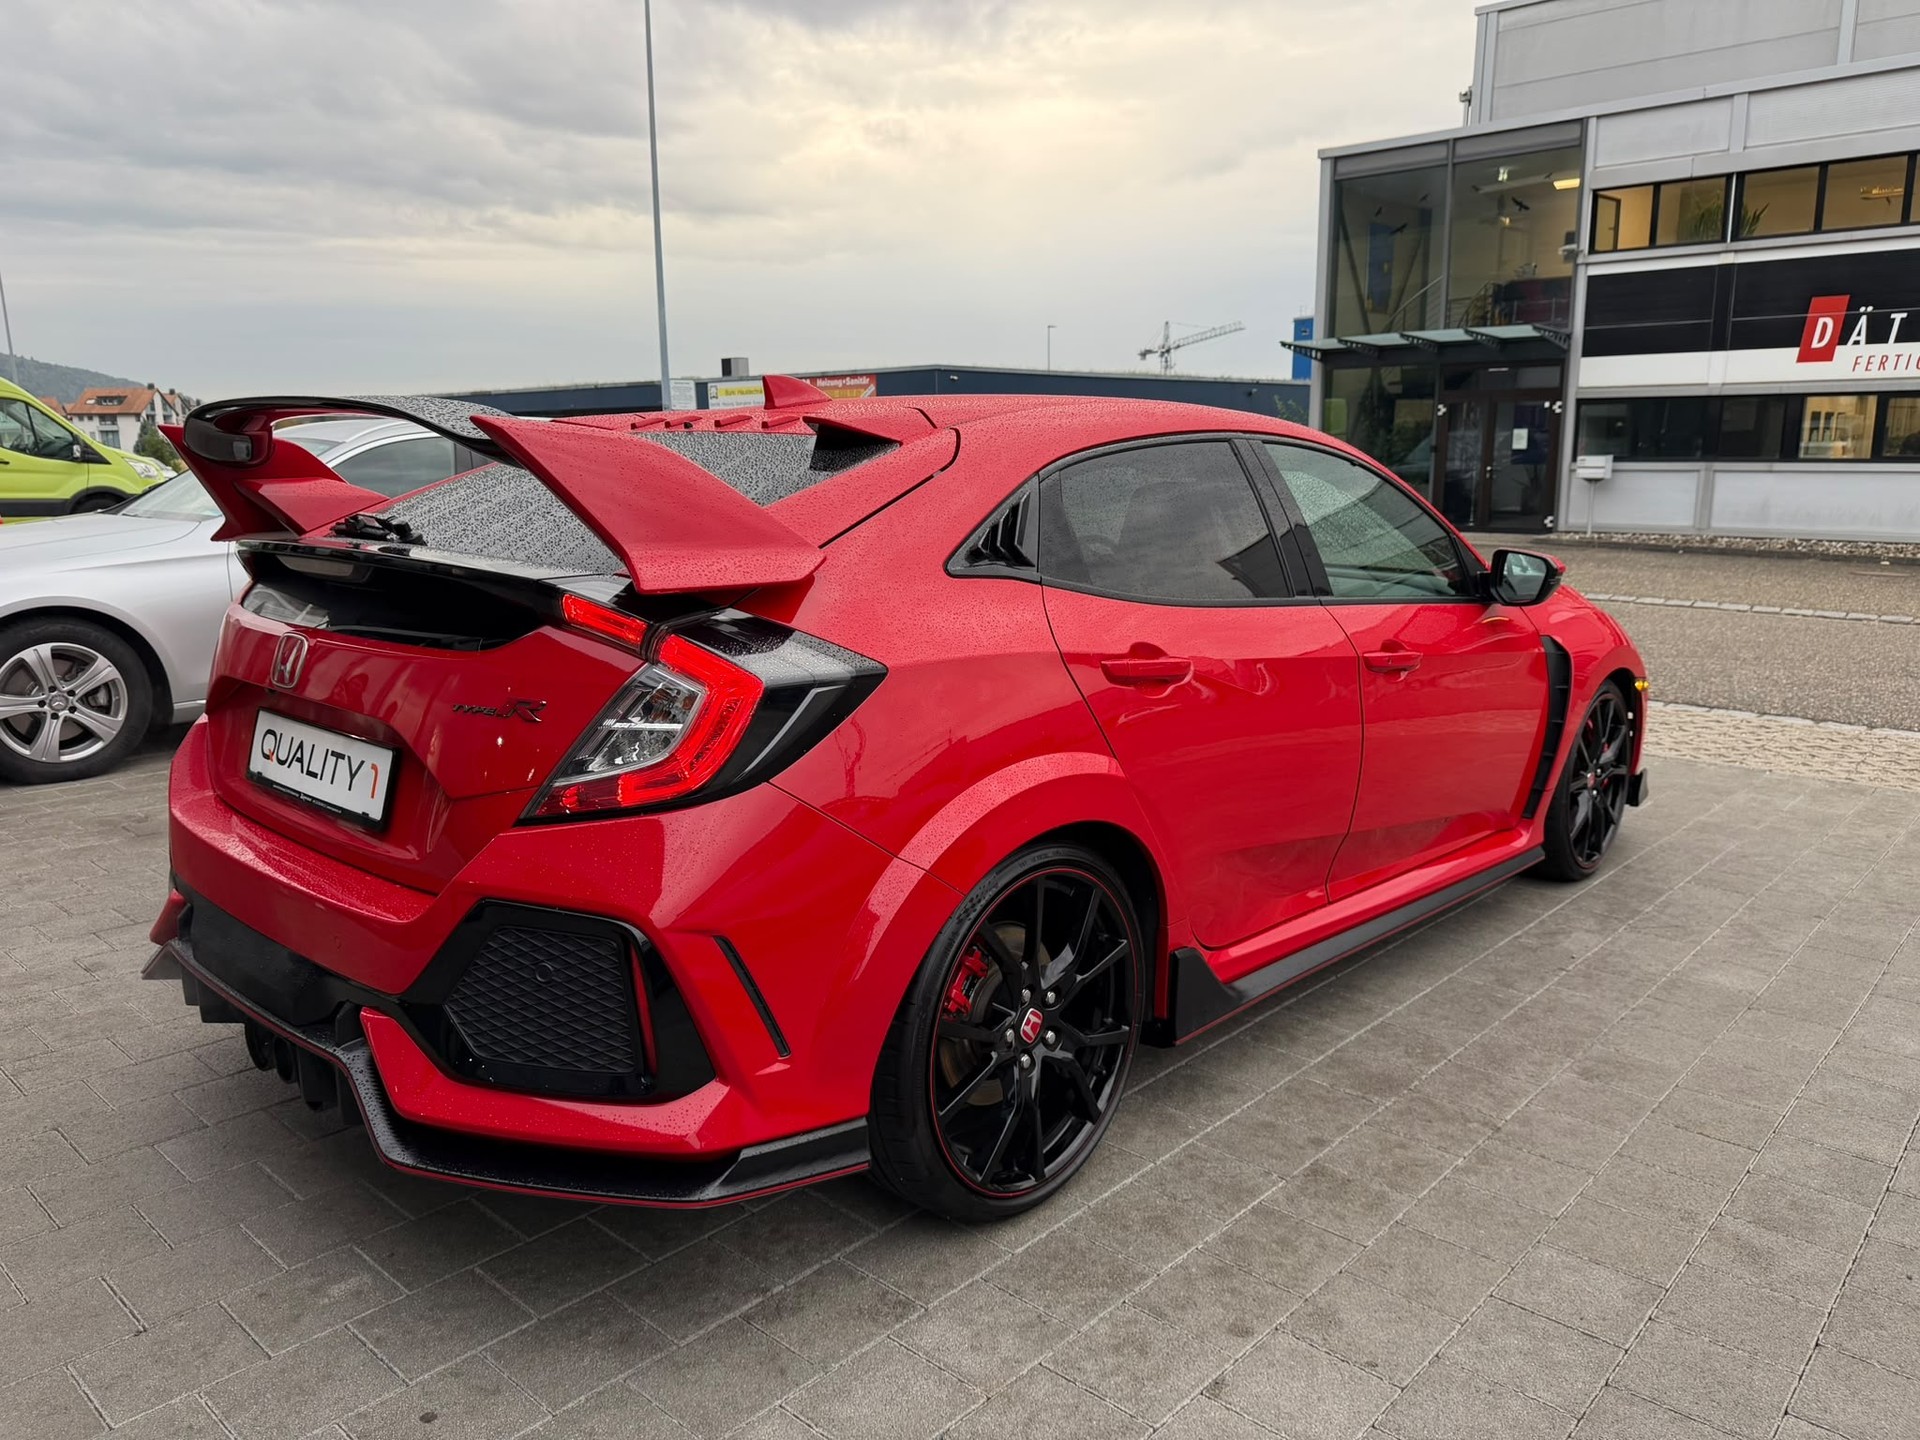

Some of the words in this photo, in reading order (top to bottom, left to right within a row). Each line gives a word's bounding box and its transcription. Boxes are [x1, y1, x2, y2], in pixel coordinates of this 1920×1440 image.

[816, 378, 842, 387] Heizung
[846, 376, 870, 385] Sanitär
[261, 729, 365, 791] QUALITY
